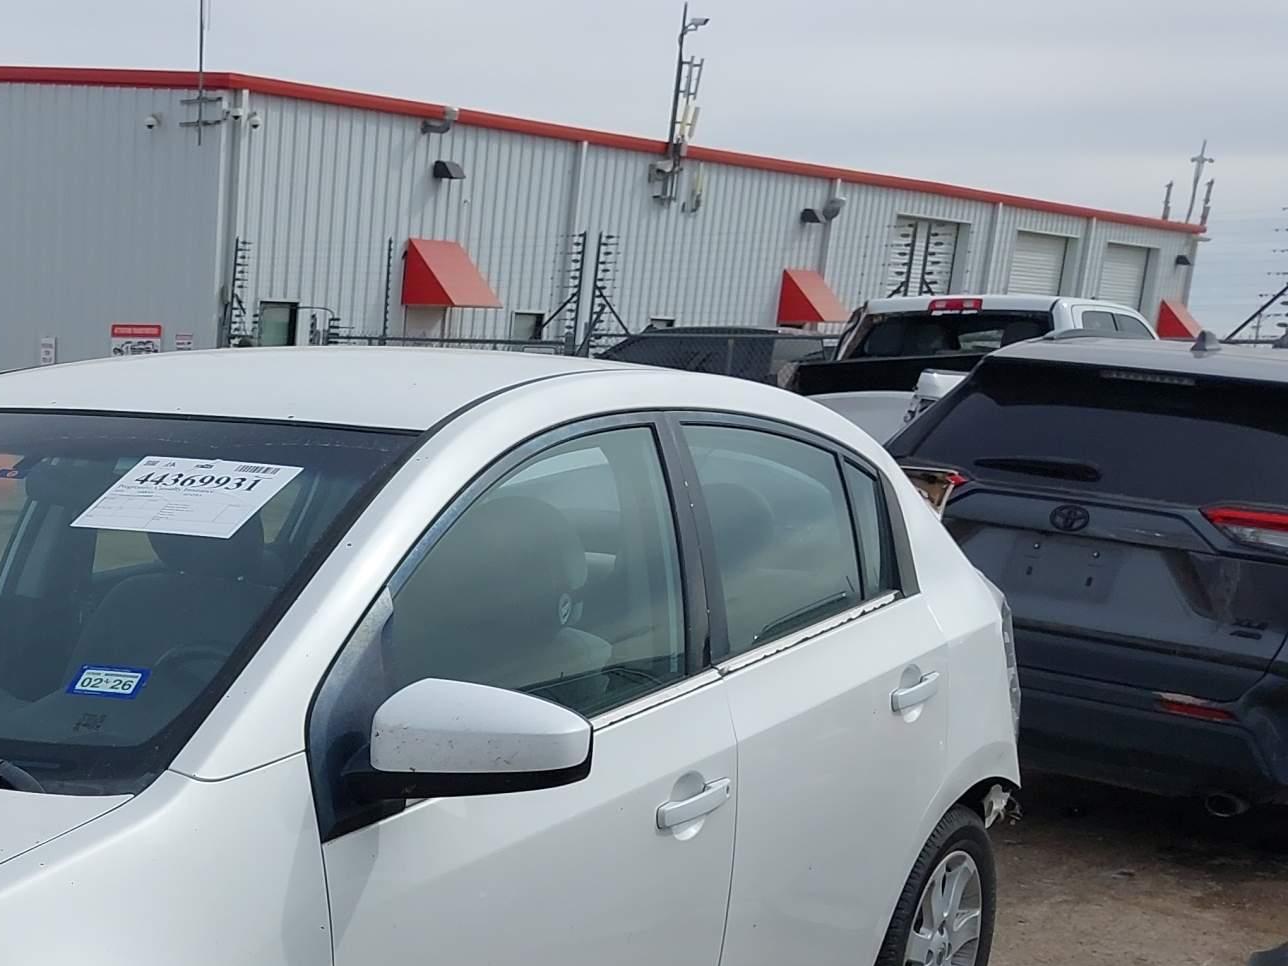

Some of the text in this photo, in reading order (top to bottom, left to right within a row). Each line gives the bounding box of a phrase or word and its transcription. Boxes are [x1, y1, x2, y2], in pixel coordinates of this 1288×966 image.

[134, 471, 262, 492] 44369931
[80, 677, 134, 691] 02 26
